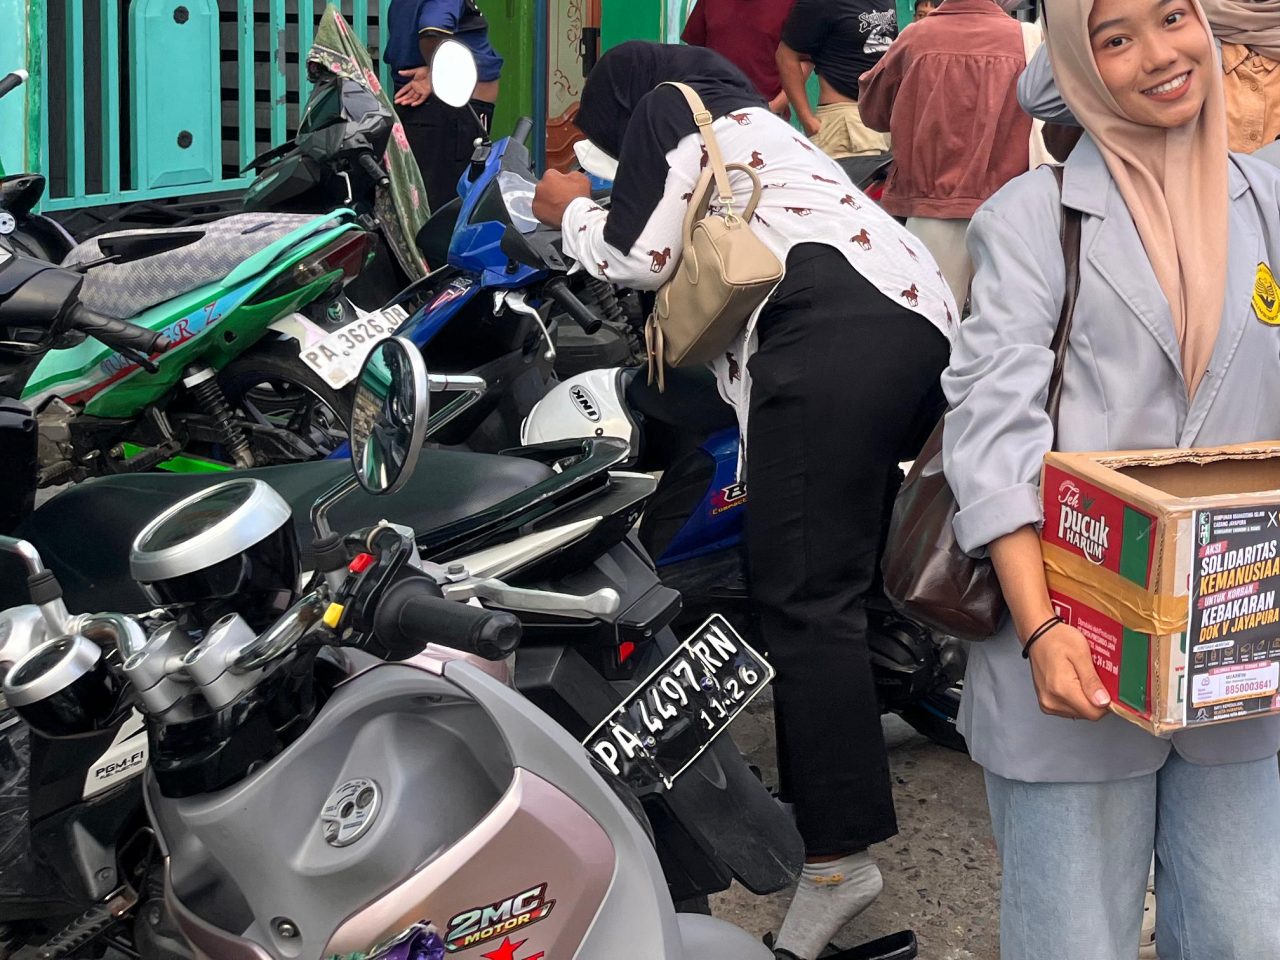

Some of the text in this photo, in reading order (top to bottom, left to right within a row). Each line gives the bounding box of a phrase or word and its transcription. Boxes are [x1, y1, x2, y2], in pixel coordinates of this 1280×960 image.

[204, 301, 222, 326] Z
[305, 345, 339, 369] PA
[338, 319, 385, 349] 3626
[1058, 484, 1080, 508] Teh
[1066, 529, 1104, 562] HARUM
[1201, 540, 1277, 576] SOLIDARITAS
[1205, 543, 1222, 556] AKSI
[1201, 590, 1275, 628] KEBAKARAN
[1204, 584, 1254, 607] UNTUK KORBAN
[1199, 623, 1220, 643] DOK
[1222, 620, 1230, 636] V
[1231, 607, 1280, 633] JAYAPURA
[594, 624, 737, 776] PA 4497 RN
[1225, 680, 1272, 696] 8850003641
[448, 886, 542, 942] 2MC
[464, 913, 531, 946] MOTOR
